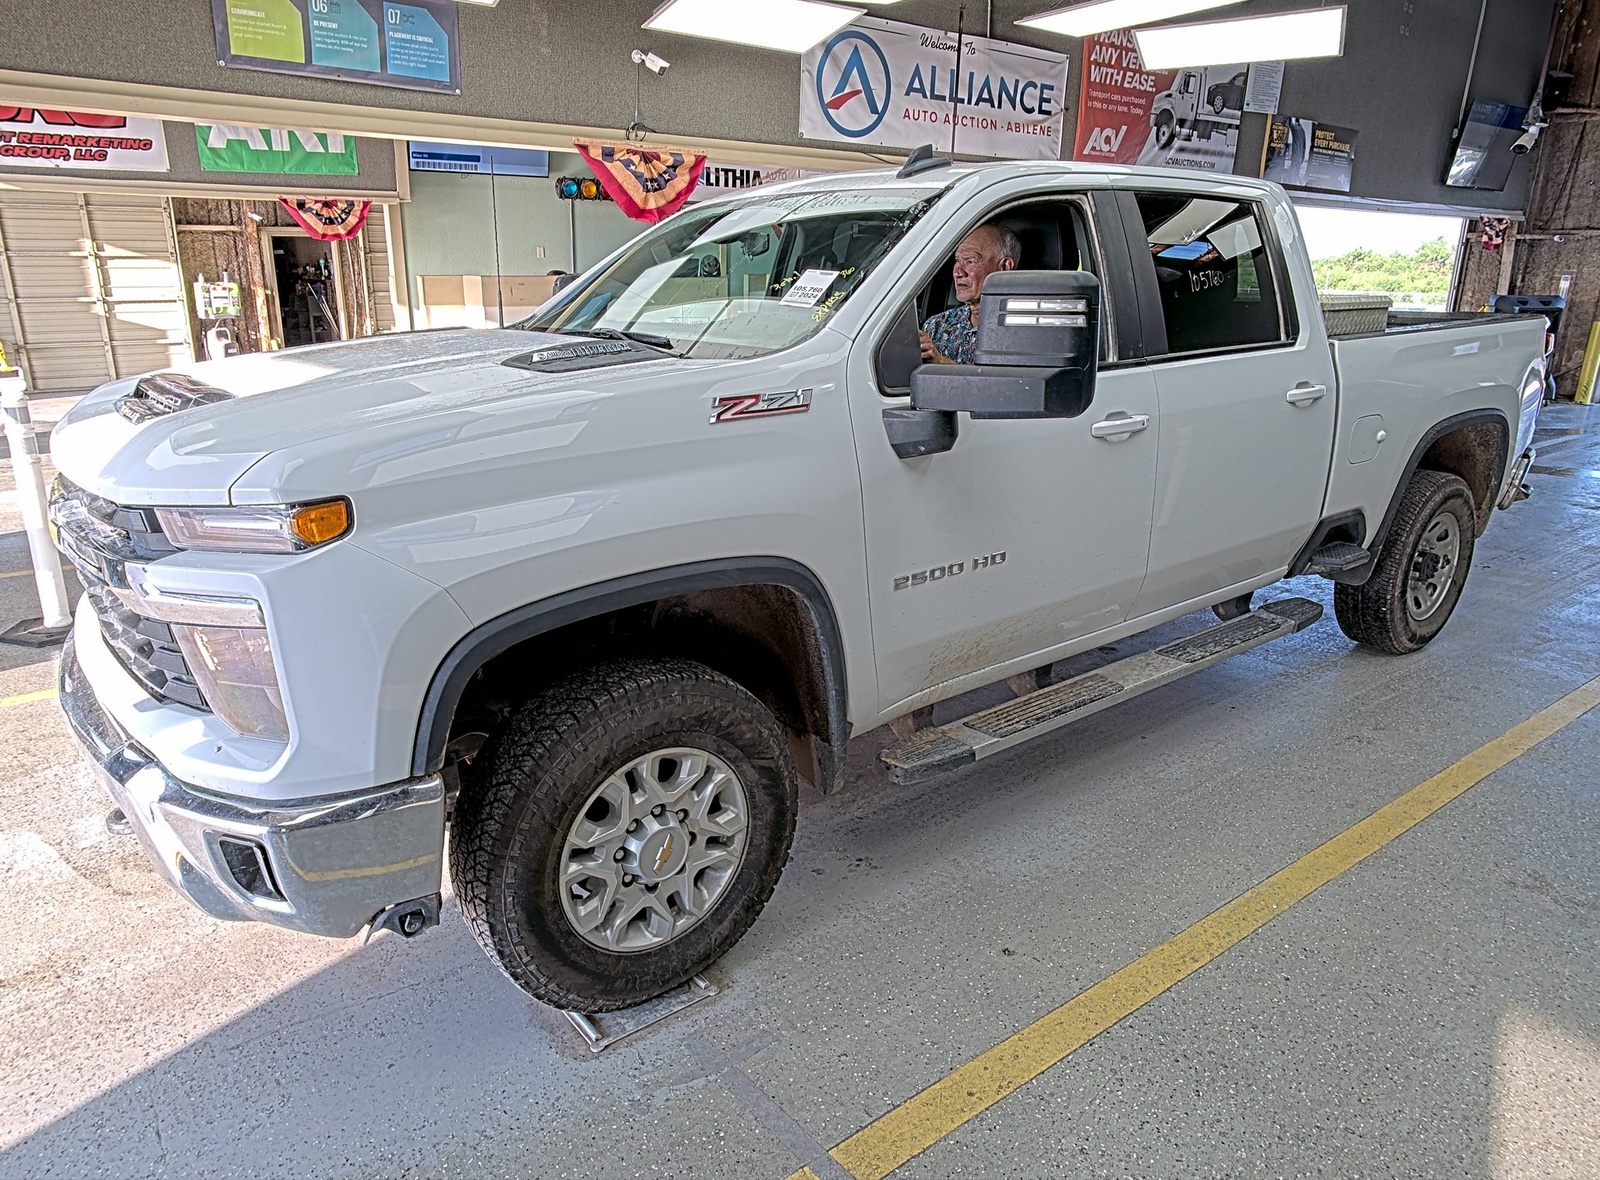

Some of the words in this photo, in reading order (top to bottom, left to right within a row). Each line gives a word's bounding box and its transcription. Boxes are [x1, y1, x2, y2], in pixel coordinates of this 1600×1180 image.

[312, 0, 328, 13] 06
[388, 8, 400, 24] 07
[320, 20, 338, 29] PRESENT
[389, 31, 411, 40] PLACEMENT
[416, 35, 434, 43] CRITICAL
[964, 40, 976, 56] To
[1090, 45, 1120, 65] ANY
[1090, 65, 1123, 86] WITH
[1124, 71, 1156, 92] EASE.
[904, 63, 1055, 116] ALLIANCE
[1088, 89, 1110, 99] Transport
[1122, 95, 1146, 105] purchased
[1130, 106, 1144, 116] Today.
[903, 108, 938, 123] AUTO
[943, 113, 997, 131] AUCTION
[1006, 121, 1052, 137] ABILENE
[17, 132, 152, 150] REMARKETING
[1082, 124, 1128, 154] ACV
[1315, 130, 1335, 140] PROTECT
[0, 144, 71, 161] GROUP,
[74, 149, 108, 161] LLC
[1314, 138, 1330, 148] EVERY
[1329, 141, 1350, 152] PURCHASE.
[705, 166, 763, 188] LITHIA
[766, 172, 787, 181] AUTO
[792, 285, 823, 293] 105,760
[709, 387, 813, 424] Z71
[894, 560, 964, 592] 2500
[972, 550, 1006, 571] HD
